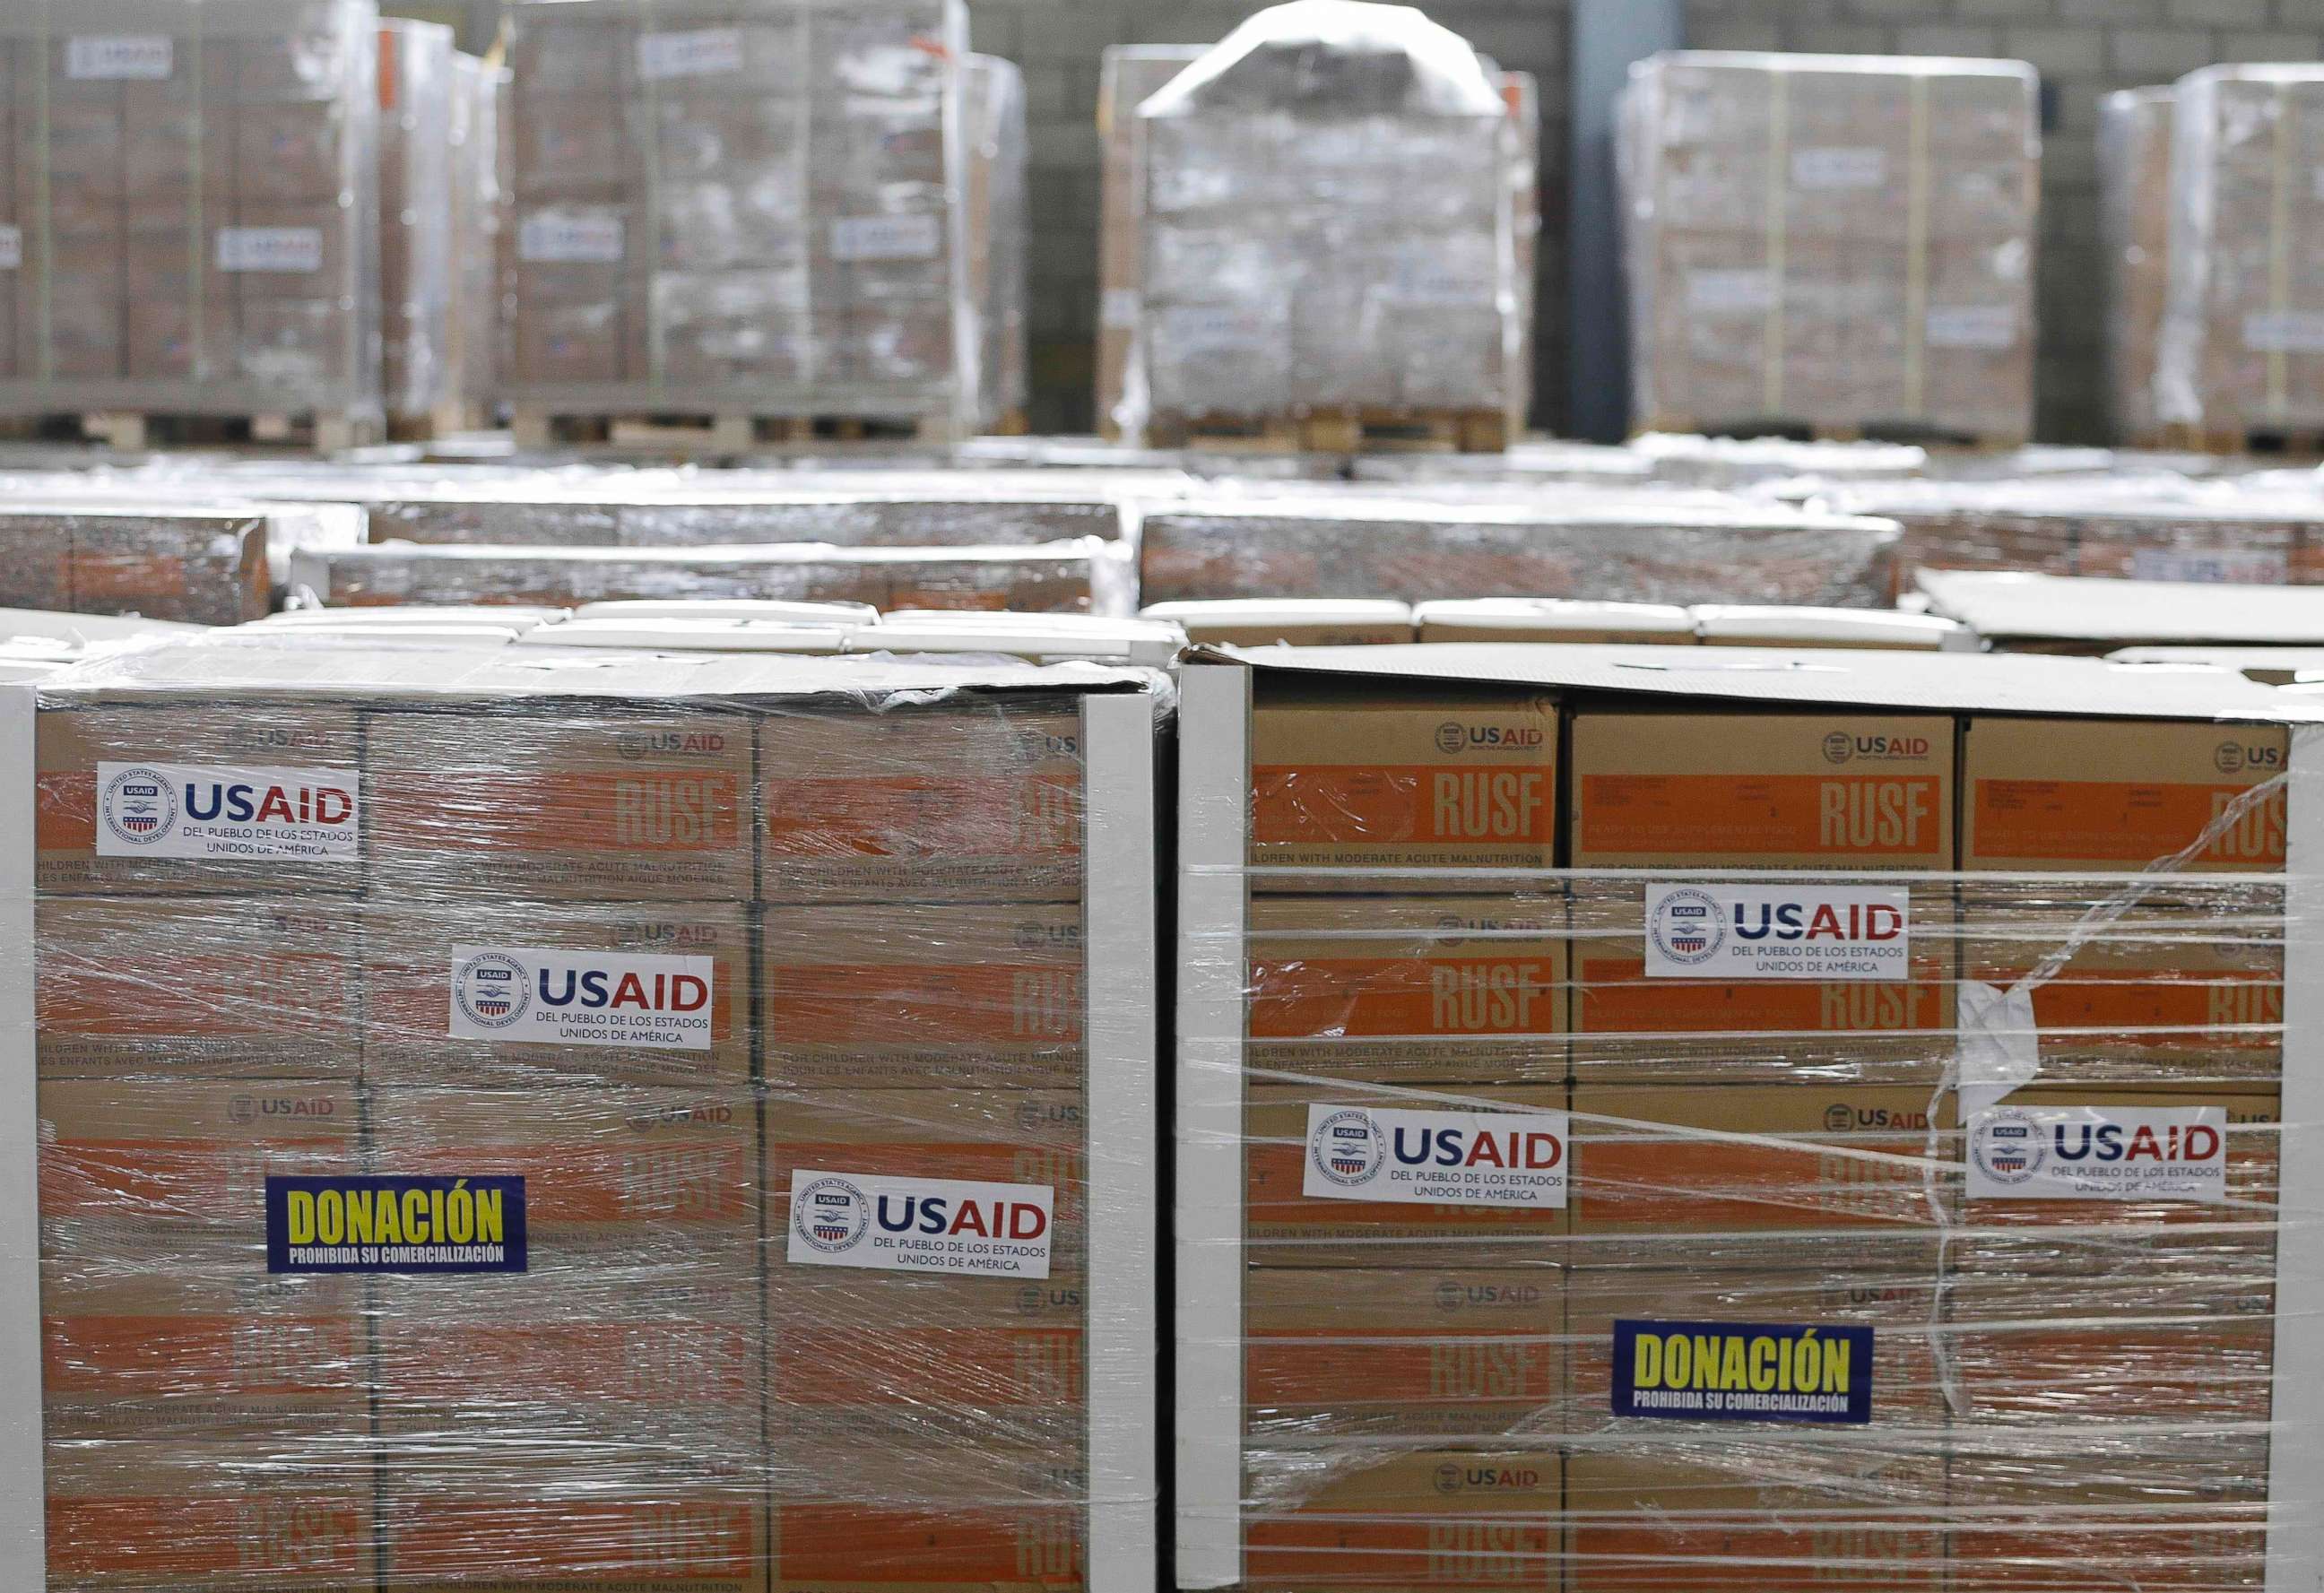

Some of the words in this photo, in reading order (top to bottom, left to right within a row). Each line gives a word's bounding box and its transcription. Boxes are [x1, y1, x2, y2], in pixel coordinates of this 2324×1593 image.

[651, 732, 724, 751] USAID
[1470, 727, 1543, 746] USAID
[1857, 736, 1929, 755] USAID
[108, 775, 127, 793] UNITED
[152, 775, 174, 794] AGENCY
[126, 786, 154, 795] USAID
[186, 784, 351, 824] USAID
[616, 776, 724, 845] RUSF
[1435, 773, 1542, 837] RUSF
[1820, 782, 1929, 846] RUSF
[106, 805, 142, 843] INTERNATIONAL
[143, 808, 176, 843] DEVELOPMENT
[184, 827, 204, 836] DEL
[208, 827, 252, 838] PUEBLO
[256, 829, 273, 839] DE
[275, 830, 297, 840] LOS
[301, 831, 352, 842] ESTADOS
[207, 843, 254, 853] UNIDOS
[257, 844, 273, 853] DE
[276, 843, 328, 855] AMÉRICA
[1249, 853, 1295, 863] ILDREN
[1299, 853, 1330, 863] WITH
[1334, 853, 1402, 863] MODERATE
[1405, 853, 1446, 863] ACUTE
[1451, 853, 1543, 864] MALNUTRITION
[37, 861, 90, 870] HILDREN
[588, 862, 630, 871] ACUTE
[1734, 904, 1903, 940] USAID
[1732, 946, 1754, 957] DEL
[1757, 947, 1802, 957] PUEBLO
[1806, 947, 1821, 957] DE
[1825, 947, 1846, 957] LOS
[1851, 947, 1903, 957] ESTADOS
[461, 958, 481, 977] UNITED
[506, 959, 527, 979] AGENCY
[480, 971, 508, 979] USAID
[1756, 962, 1803, 972] UNIDOS
[1808, 962, 1823, 972] DE
[1826, 959, 1877, 973] AMÉRICA
[539, 968, 707, 1011] USAID
[1435, 964, 1541, 1029] RUSF
[457, 990, 495, 1026] INTERNATIONAL
[497, 993, 529, 1026] DEVELOPMENT
[1014, 973, 1076, 1035] RU
[1820, 977, 1929, 1030] RUSF
[536, 1012, 559, 1023] DEL
[562, 1012, 606, 1025] PUEBLO
[611, 1015, 627, 1026] DE
[630, 1016, 651, 1026] LOS
[655, 1016, 708, 1028] ESTADOS
[560, 1028, 607, 1040] UNIDOS
[611, 1030, 627, 1041] DE
[630, 1028, 682, 1043] AMÉRICA
[1299, 1046, 1331, 1057] WITH
[1335, 1046, 1403, 1057] MODERATE
[1406, 1046, 1447, 1057] ACUTE
[262, 1099, 334, 1116] USAID
[1858, 1109, 1929, 1130] USAID
[1394, 1128, 1562, 1170] USAID
[2055, 1125, 2219, 1161] USAID
[1392, 1171, 1412, 1182] DEL
[1417, 1172, 1461, 1182] PUEBLO
[1465, 1173, 1480, 1183] DE
[1484, 1173, 1505, 1184] LOS
[1510, 1174, 1562, 1186] ESTADOS
[2051, 1167, 2073, 1177] DEL
[2077, 1167, 2120, 1177] PUEBLO
[2125, 1167, 2139, 1177] DE
[2144, 1167, 2164, 1177] LOS
[2168, 1167, 2219, 1177] ESTADOS
[800, 1183, 820, 1201] UNITED
[818, 1196, 847, 1205] USAID
[1415, 1186, 1461, 1198] UNIDOS
[1466, 1188, 1481, 1199] DE
[1485, 1186, 1537, 1201] AMÉRICA
[288, 1179, 503, 1245] DONACIÓN
[877, 1196, 1046, 1239] USAID
[796, 1214, 832, 1251] INTERNATIONAL
[834, 1218, 868, 1251] DEVELOPMENT
[1301, 1229, 1332, 1240] WITH
[1335, 1229, 1403, 1239] MODERATE
[290, 1246, 359, 1264] PROHIBIDA
[362, 1246, 378, 1263] SU
[381, 1243, 504, 1263] COMERCIALIZACIÓN
[874, 1237, 895, 1248] DEL
[899, 1239, 943, 1251] PUEBLO
[949, 1242, 964, 1252] DE
[967, 1242, 988, 1253] LOS
[993, 1244, 1045, 1258] ESTADOS
[898, 1255, 944, 1267] UNIDOS
[949, 1256, 964, 1268] DE
[968, 1256, 1020, 1270] AMÉRICA
[1468, 1286, 1539, 1303] USAID
[1634, 1328, 1850, 1393] DONACIÓN
[1634, 1390, 1703, 1408] PROHIBIDA
[1706, 1392, 1722, 1409] SU
[1726, 1391, 1848, 1412] COMERCIALIZACIÓN
[1467, 1468, 1539, 1487] USAID
[502, 1582, 533, 1592] WITH
[536, 1582, 603, 1593] MODERATE
[608, 1583, 646, 1593] ACUTE
[652, 1582, 742, 1593] MALNUTRITION
